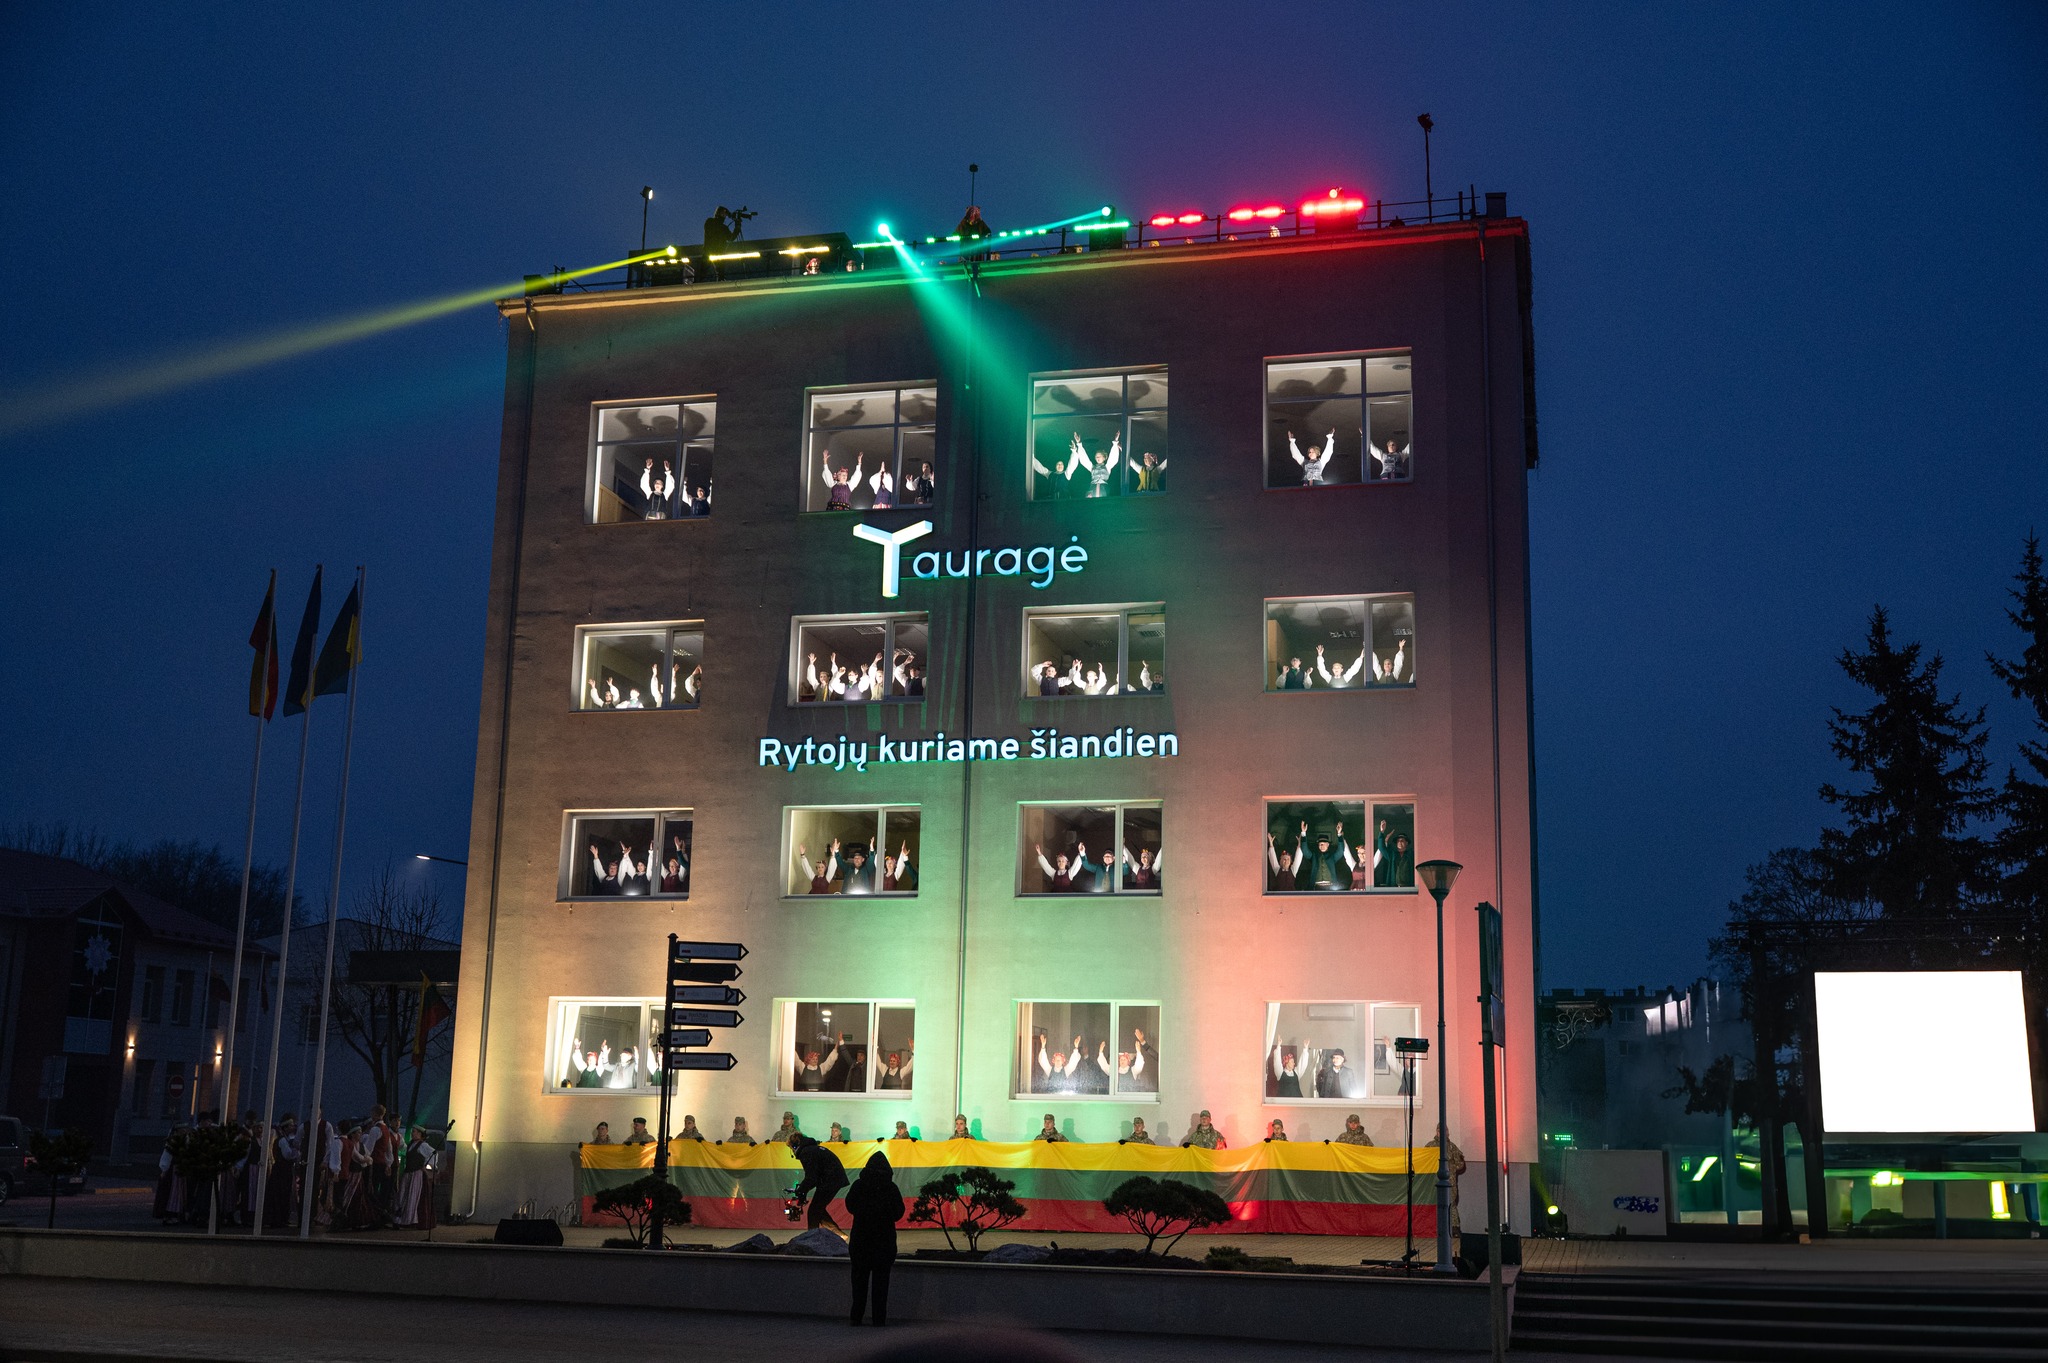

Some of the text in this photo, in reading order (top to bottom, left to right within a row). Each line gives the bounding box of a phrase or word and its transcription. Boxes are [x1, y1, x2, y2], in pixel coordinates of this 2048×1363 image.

[759, 729, 1179, 772] Rytojų kuriame šiandien
